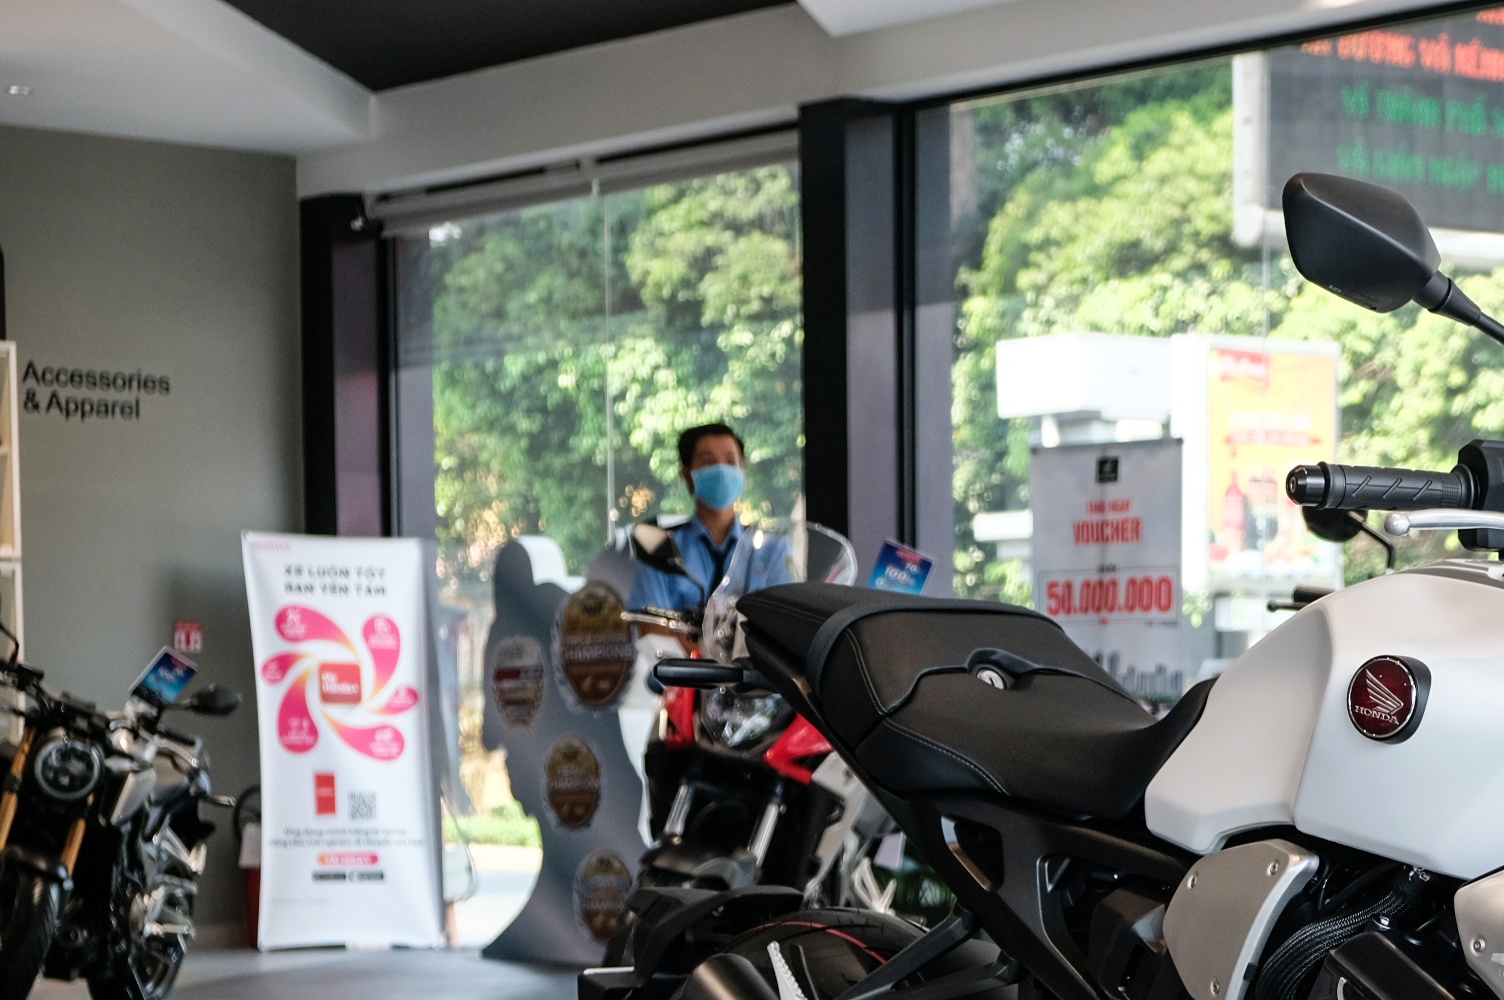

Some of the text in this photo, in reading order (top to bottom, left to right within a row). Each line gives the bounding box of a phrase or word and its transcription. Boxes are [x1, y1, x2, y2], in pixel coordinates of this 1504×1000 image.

[22, 359, 171, 396] Accessories
[23, 387, 141, 422] & Apparel
[1073, 516, 1143, 545] VOUCHER
[1046, 575, 1174, 617] 50.000.000
[1354, 704, 1400, 726] HONDA
